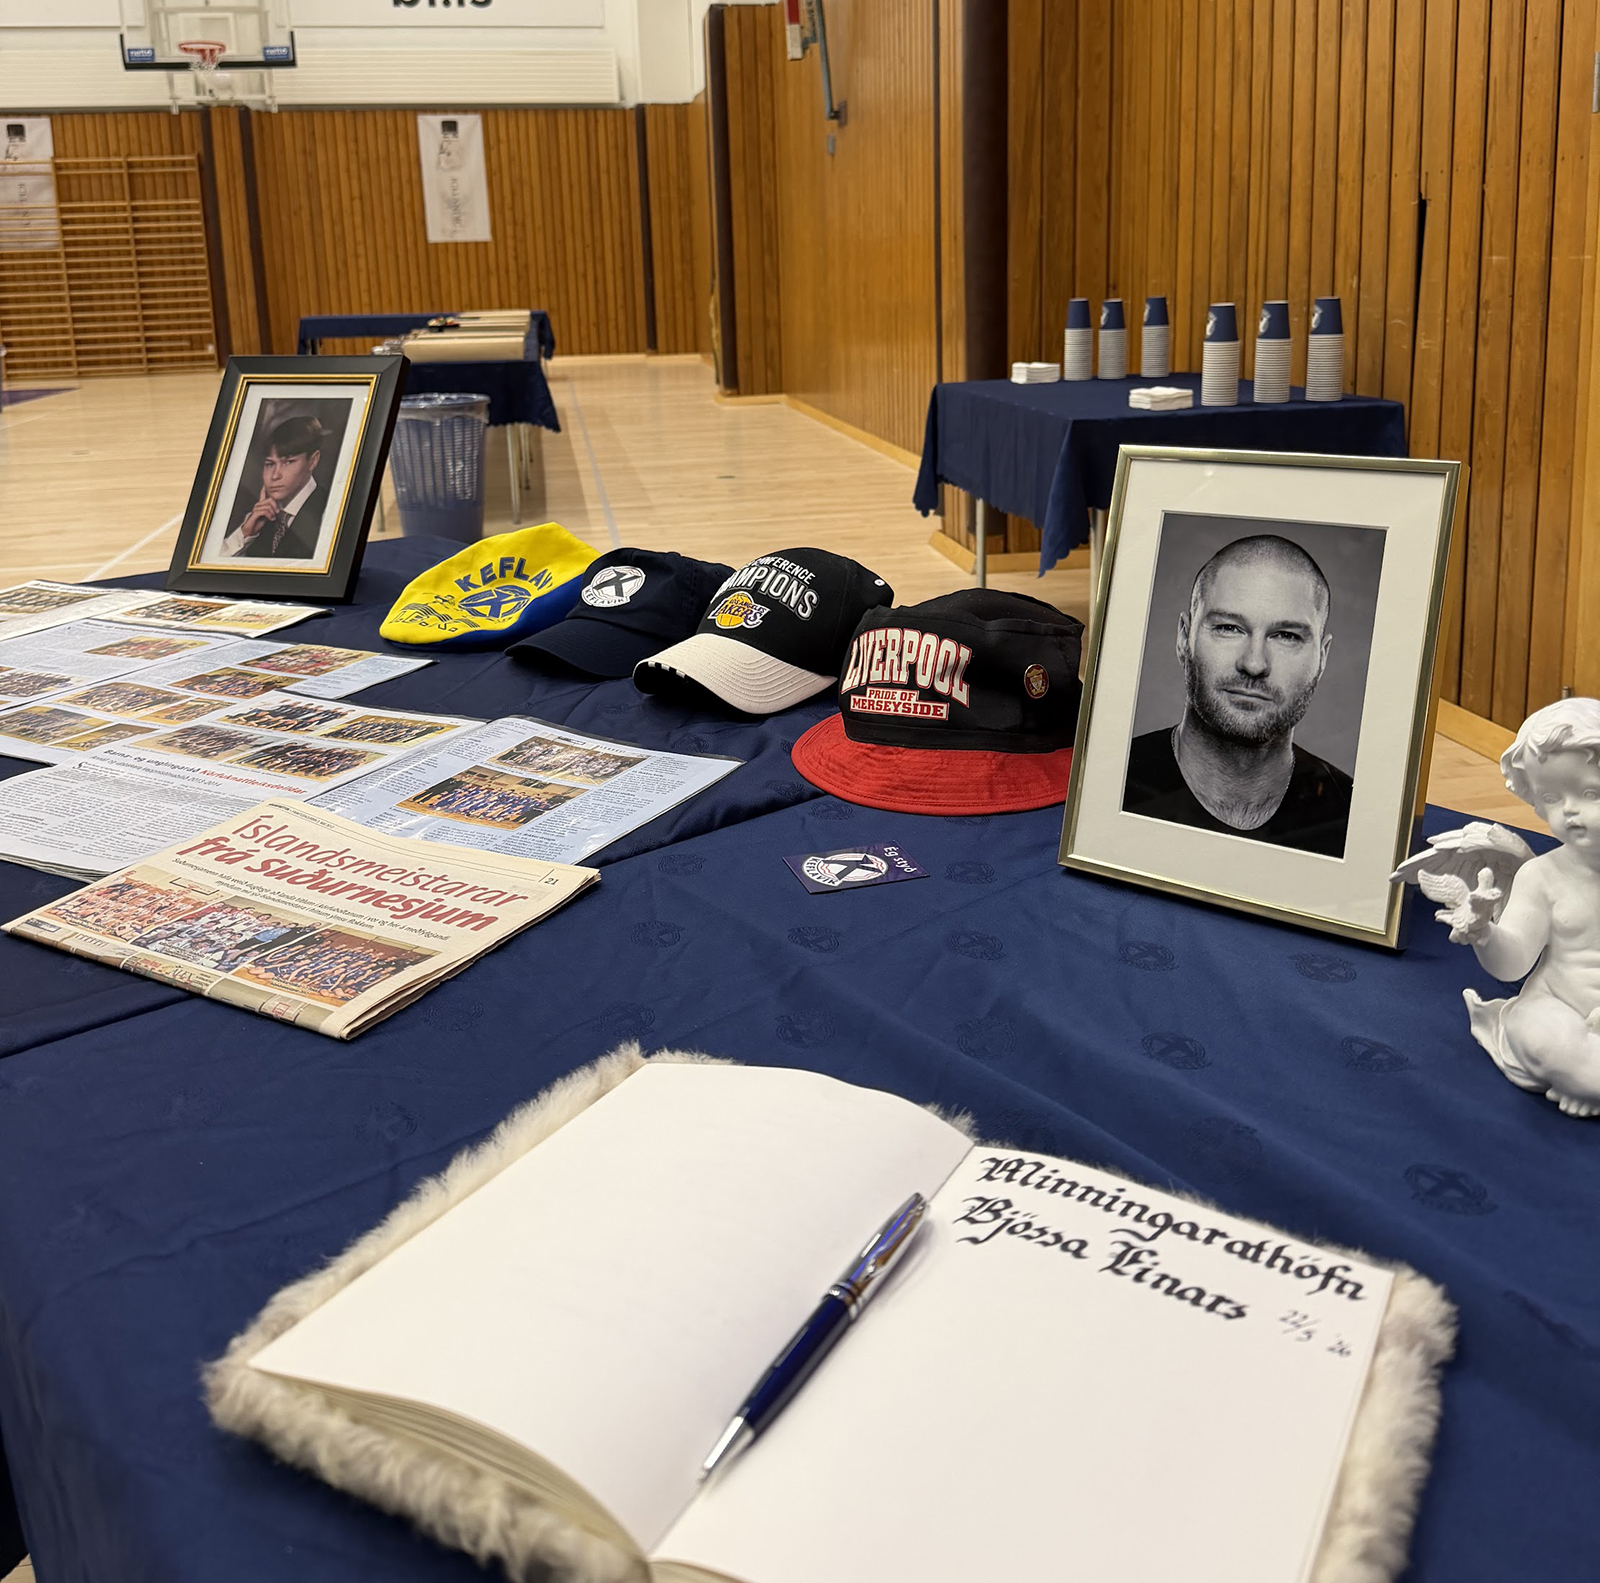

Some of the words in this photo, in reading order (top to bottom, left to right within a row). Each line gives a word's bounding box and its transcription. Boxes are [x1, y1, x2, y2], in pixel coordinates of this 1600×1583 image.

[454, 556, 554, 593] KEFLAV
[710, 599, 764, 627] LAKERS
[841, 628, 973, 708] LIVERPOOL
[852, 697, 945, 718] MERSEYSIDE
[868, 689, 897, 701] PRIDE
[900, 691, 916, 702] OF
[176, 835, 261, 865] frá
[231, 814, 529, 907] Íslandsmeistarar
[883, 846, 899, 857] Ég
[544, 876, 559, 886] 21
[976, 1157, 1367, 1300] Minningarathöfn
[953, 1196, 1089, 1260] Bjössa
[1099, 1240, 1250, 1320] Einars
